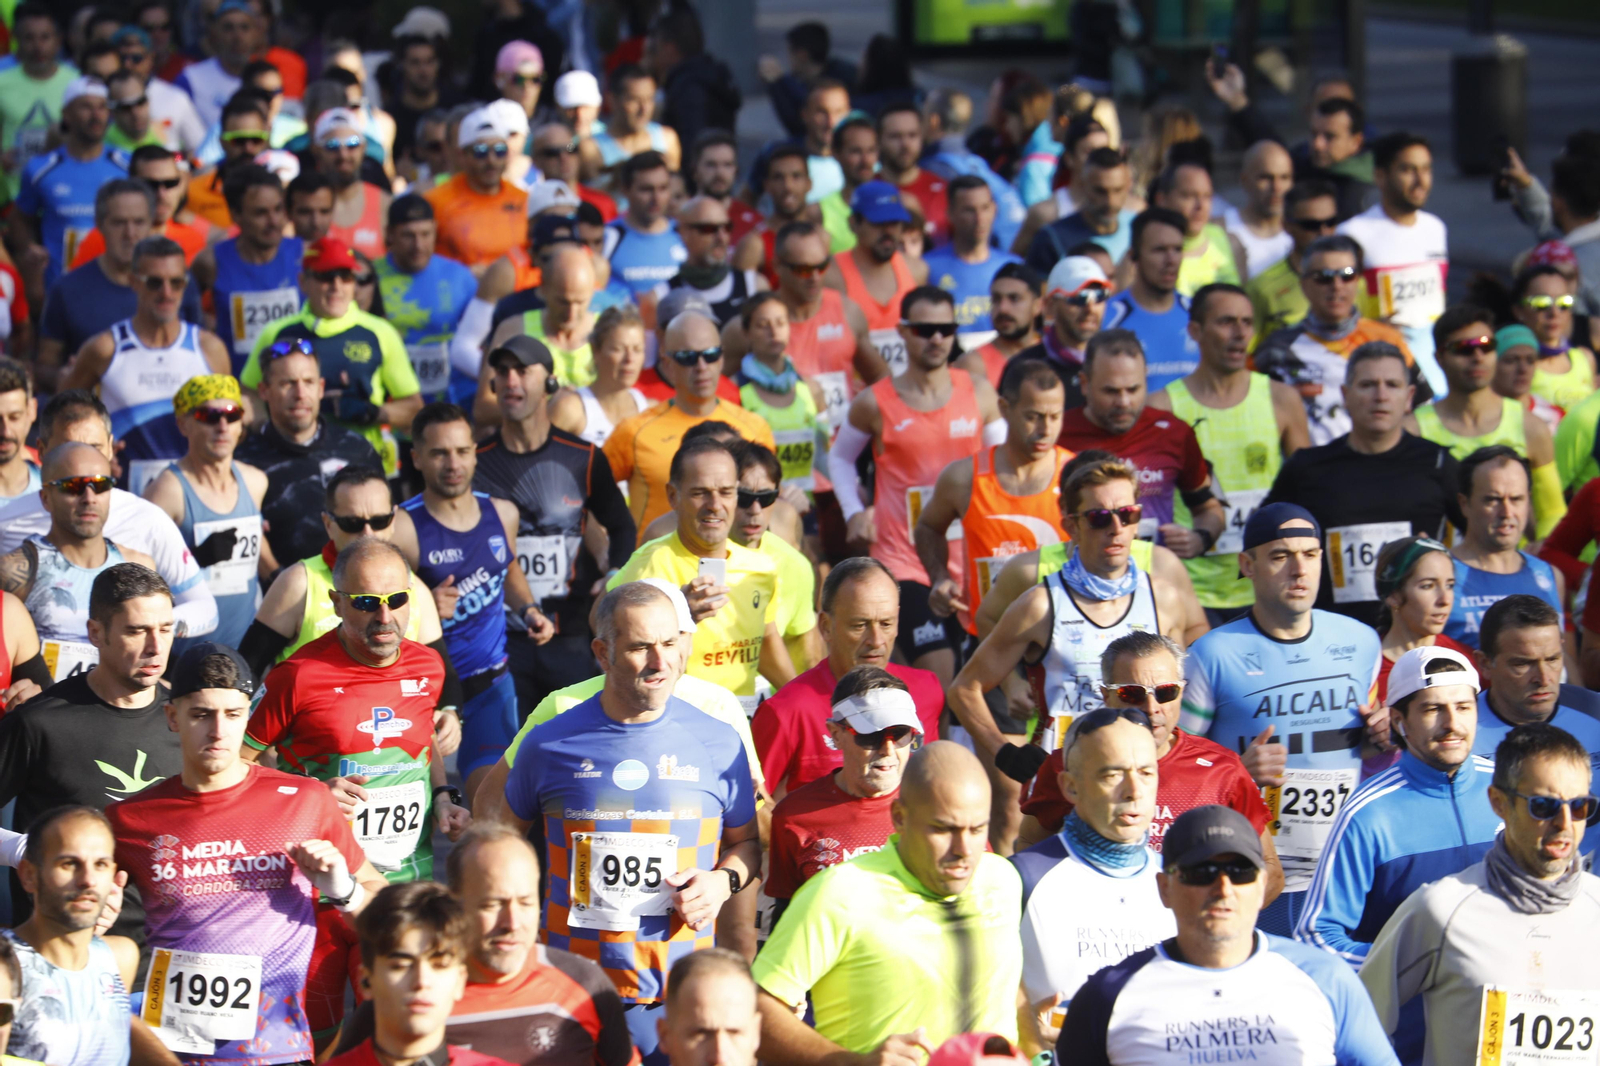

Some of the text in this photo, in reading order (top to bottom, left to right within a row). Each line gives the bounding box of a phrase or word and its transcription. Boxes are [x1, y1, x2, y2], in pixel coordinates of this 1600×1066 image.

[1252, 685, 1359, 719] ALCALA
[1281, 785, 1350, 818] 2337
[356, 801, 421, 837] 1782
[182, 839, 247, 860] MEDIA
[151, 850, 287, 883] 36 MARATÓN
[602, 853, 663, 888] 985
[169, 970, 253, 1010] 1992
[1164, 1014, 1276, 1035] RUNNERS LA
[1490, 1010, 1500, 1018] 3
[1165, 1028, 1278, 1052] PALMERA
[1508, 1011, 1595, 1052] 1023
[1188, 1048, 1258, 1065] HUELVA
